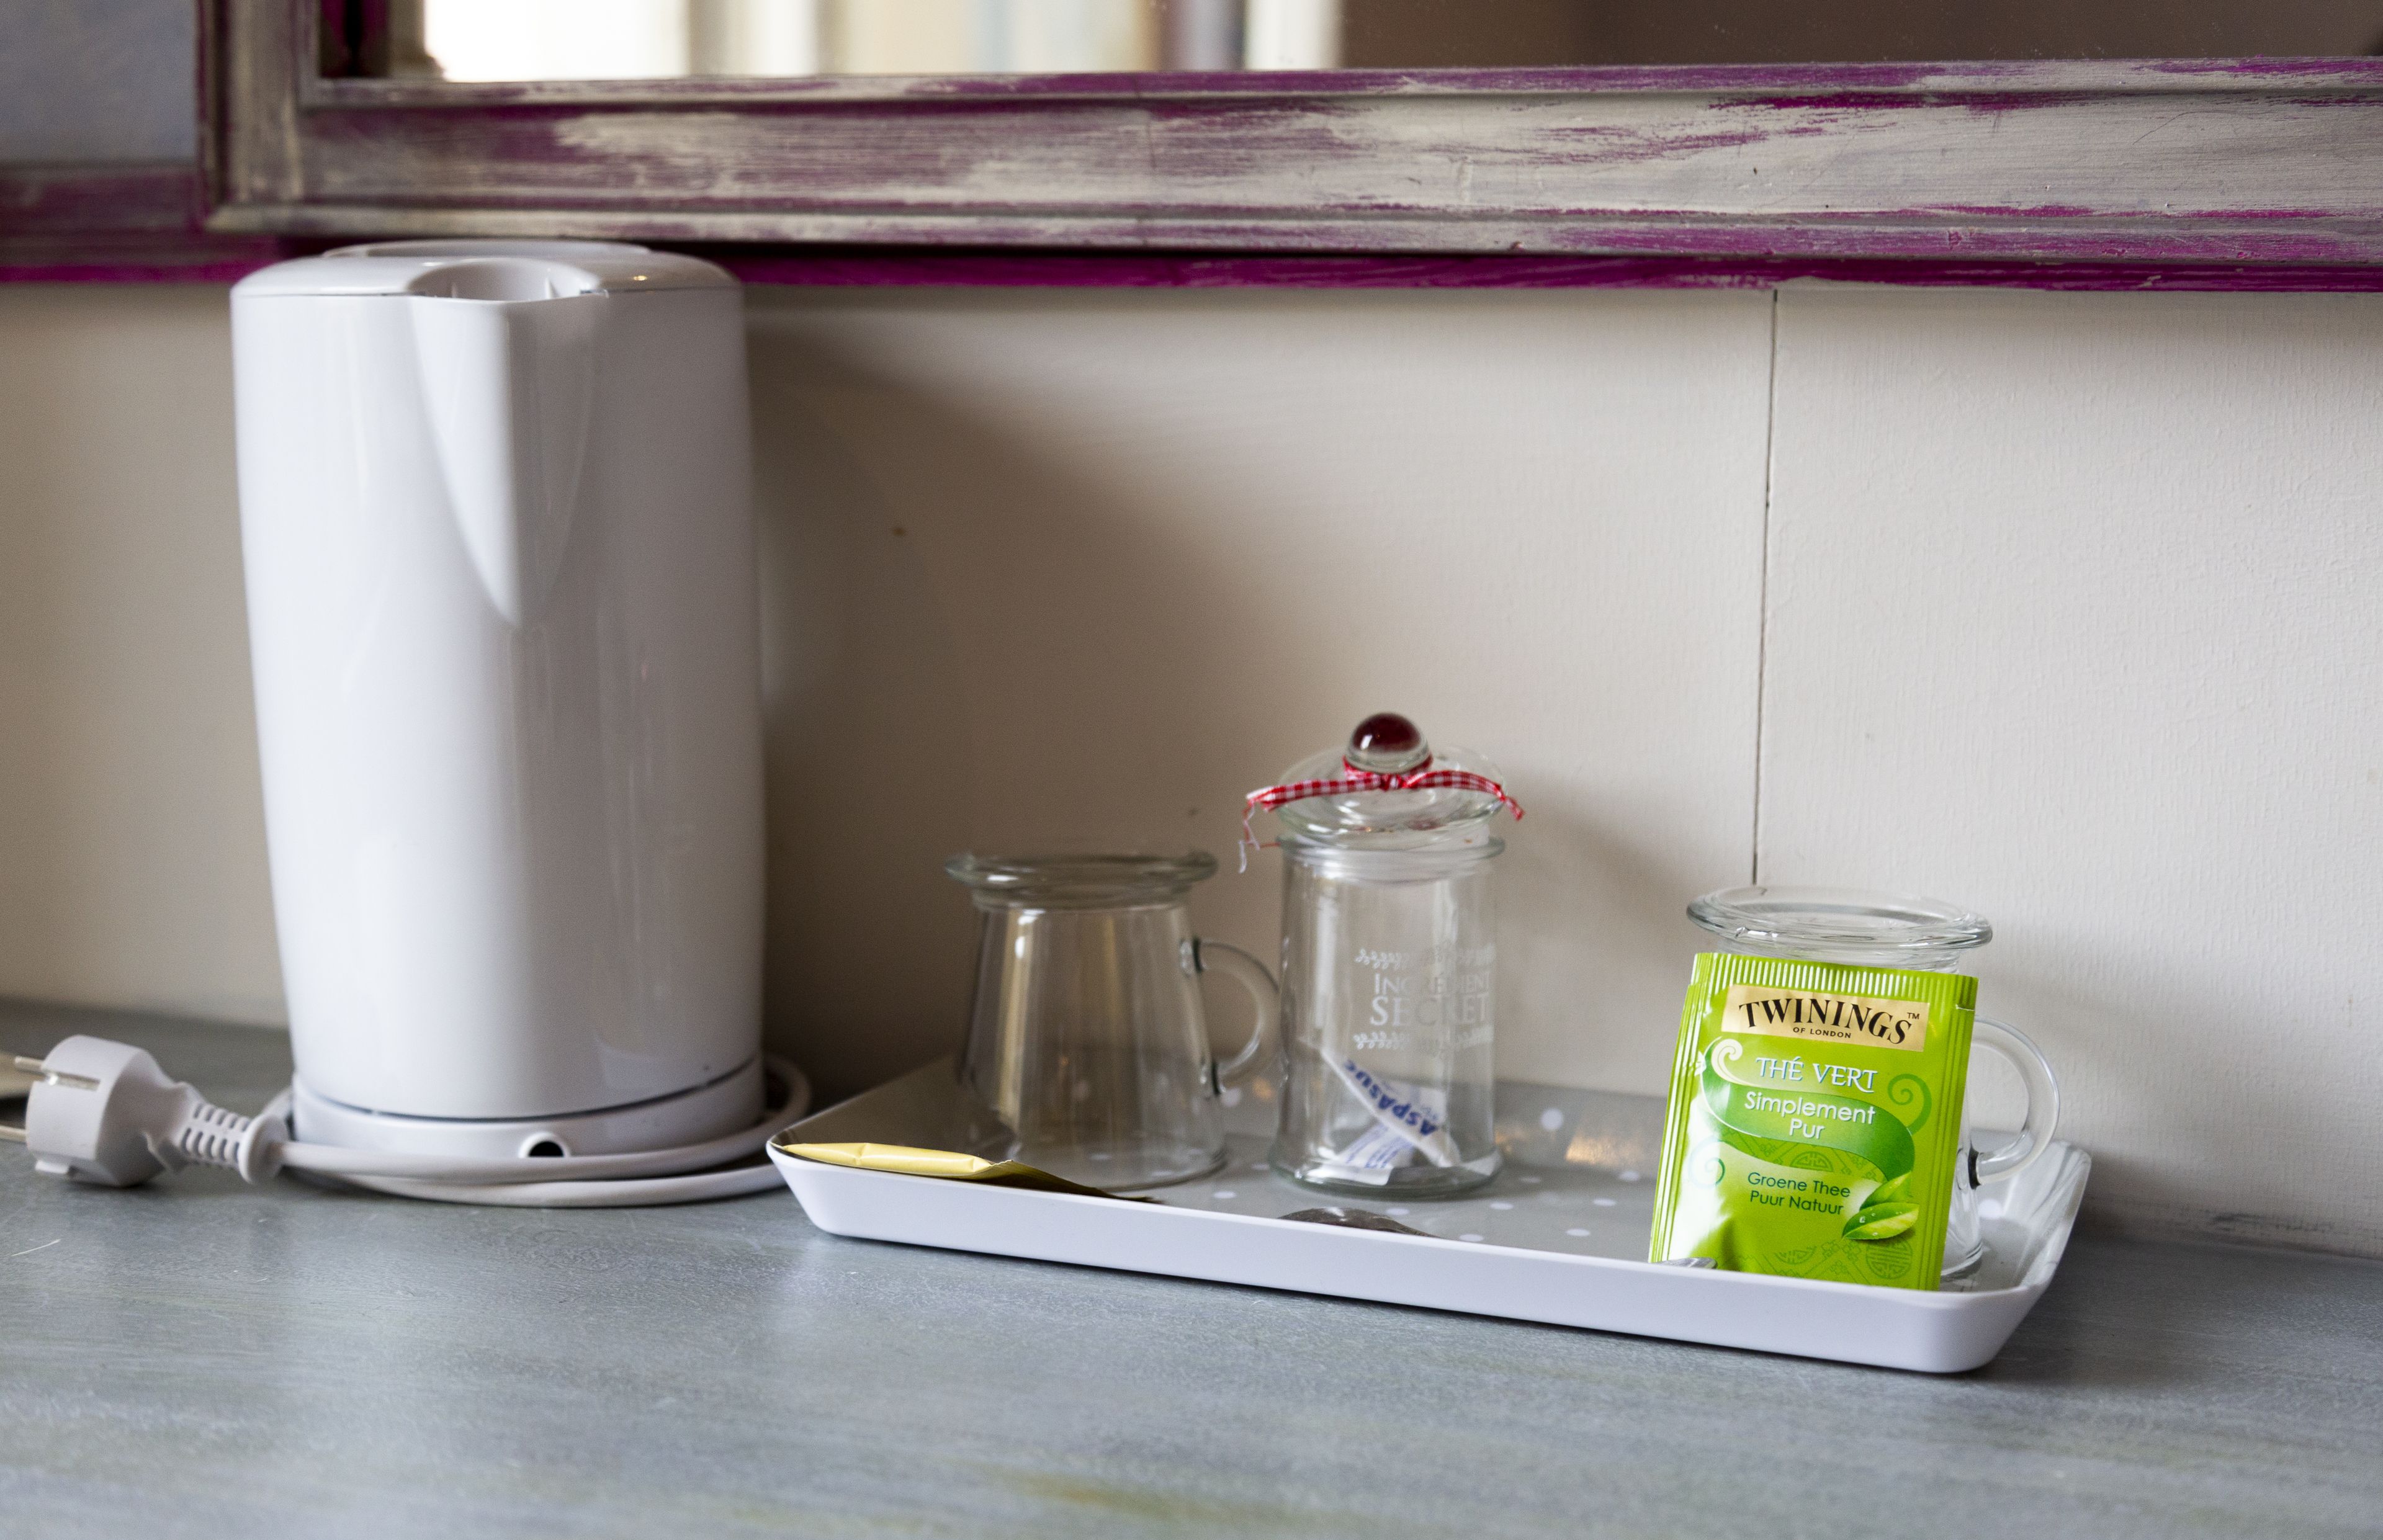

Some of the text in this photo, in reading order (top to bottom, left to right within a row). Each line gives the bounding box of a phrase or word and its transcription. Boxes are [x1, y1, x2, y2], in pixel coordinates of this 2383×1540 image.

[1739, 998, 1912, 1045] TWININGS
[1810, 1029, 1852, 1039] LONDON
[1756, 1056, 1878, 1093] THÉ VERT
[1744, 1091, 1876, 1124] Simplement
[1788, 1117, 1825, 1139] Pur
[1748, 1171, 1851, 1198] Groene Thee
[1750, 1190, 1844, 1215] Puur Natuur
